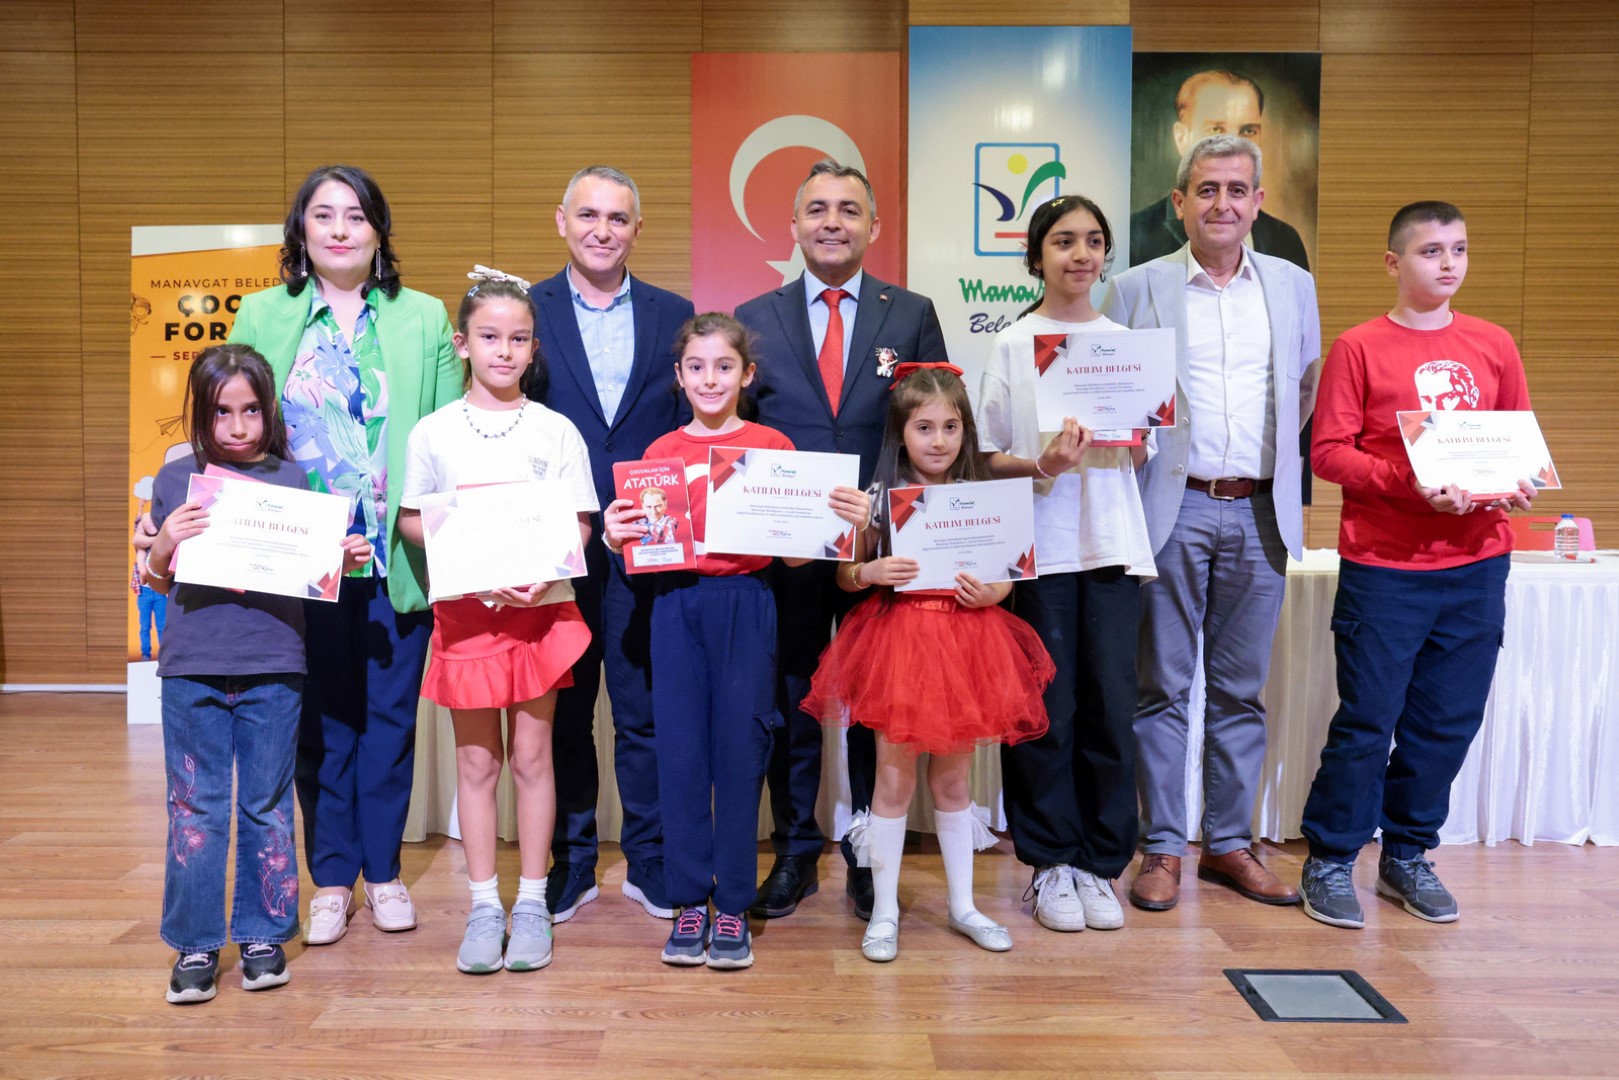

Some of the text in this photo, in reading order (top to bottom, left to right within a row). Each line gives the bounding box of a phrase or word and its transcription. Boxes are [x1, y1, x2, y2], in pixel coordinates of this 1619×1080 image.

[150, 278, 229, 288] MANAVGAT
[958, 277, 1045, 303] Manav
[164, 322, 235, 341] FOR
[623, 473, 679, 489] ATATÜRK
[743, 485, 823, 498] KATILIM BELGESİ
[925, 515, 1001, 530] KATILIM BELGESİ
